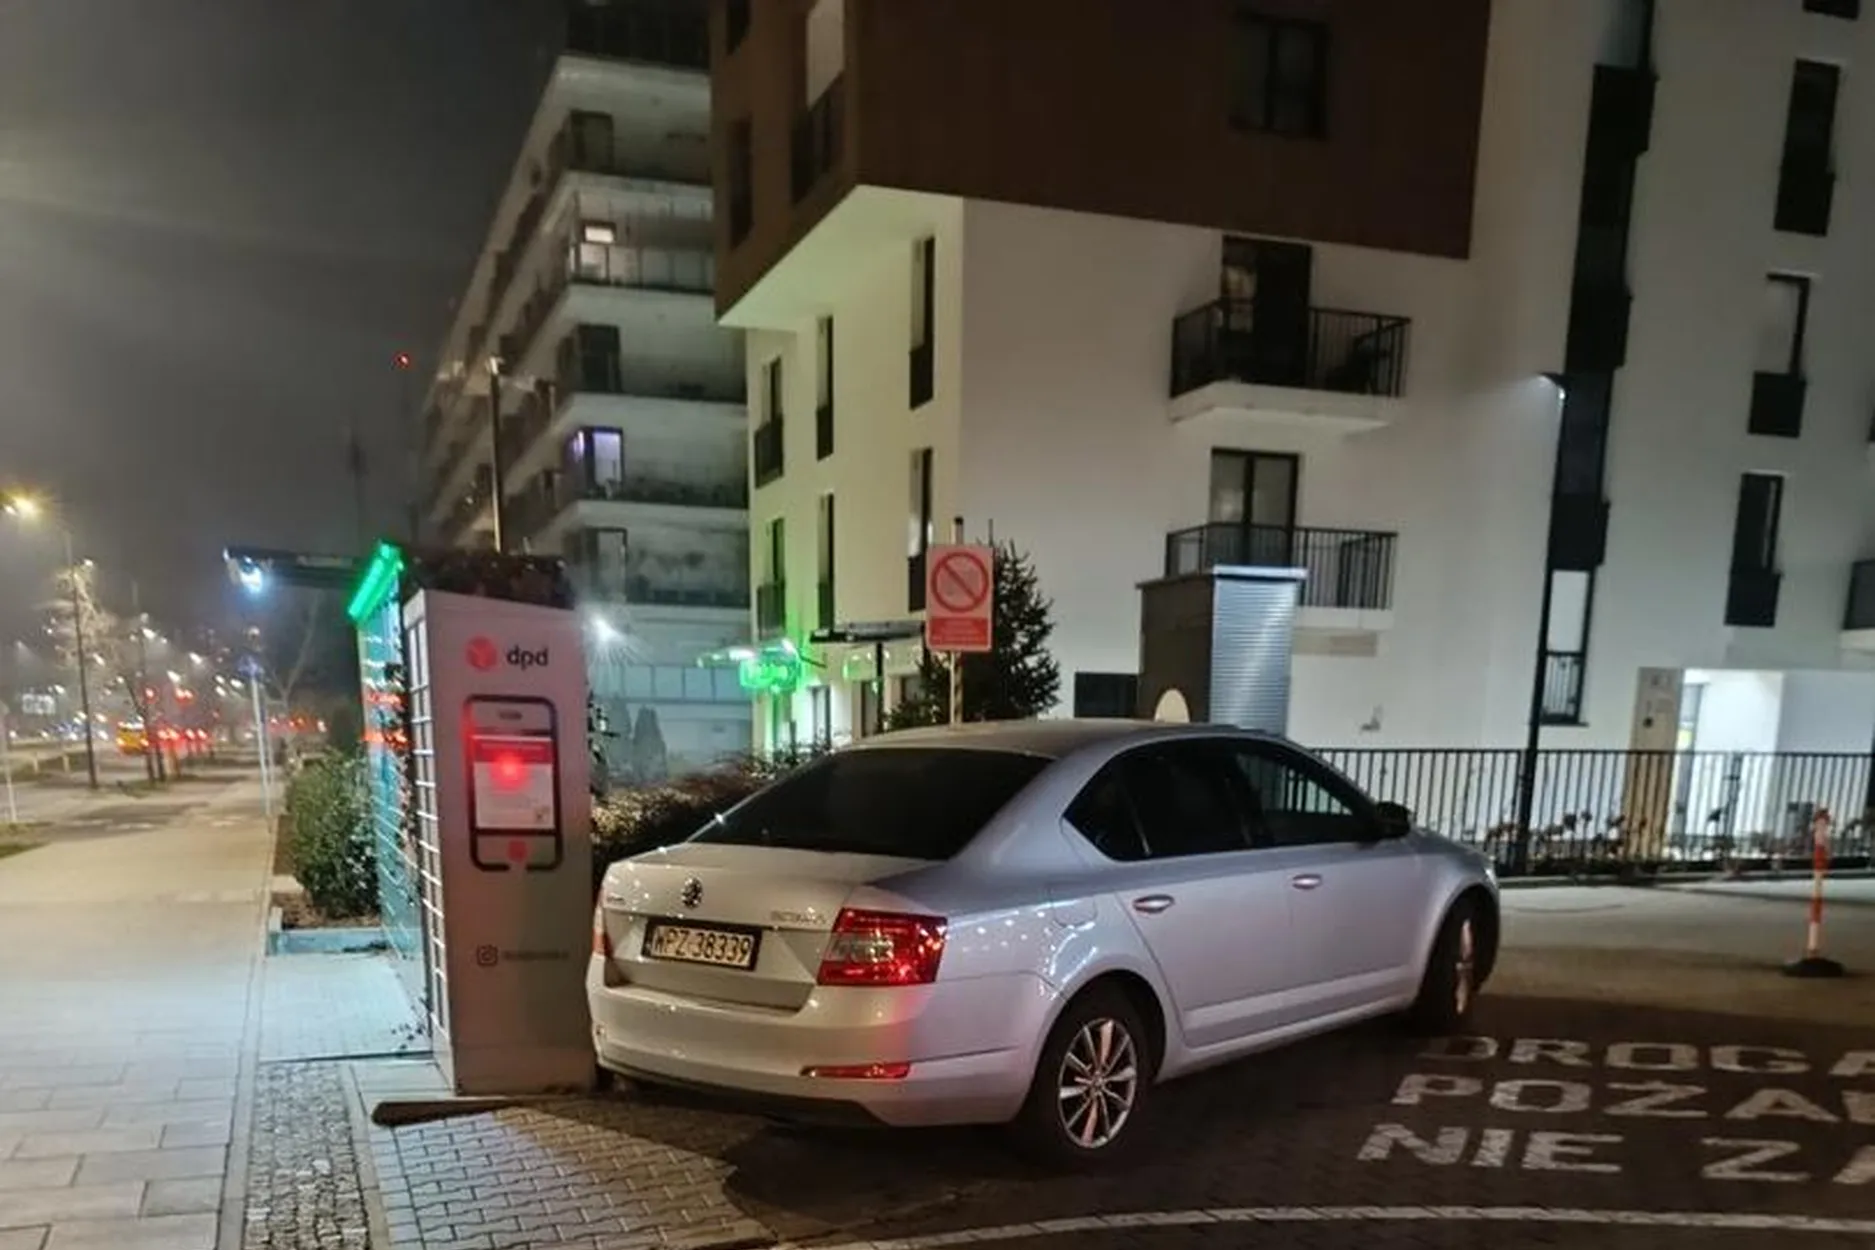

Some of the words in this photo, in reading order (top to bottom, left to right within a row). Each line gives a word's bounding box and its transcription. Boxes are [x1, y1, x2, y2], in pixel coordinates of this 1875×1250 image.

[506, 645, 549, 671] dpd
[654, 927, 689, 957] WPZ
[693, 931, 751, 965] 38339
[1357, 1124, 1624, 1172] NIE
